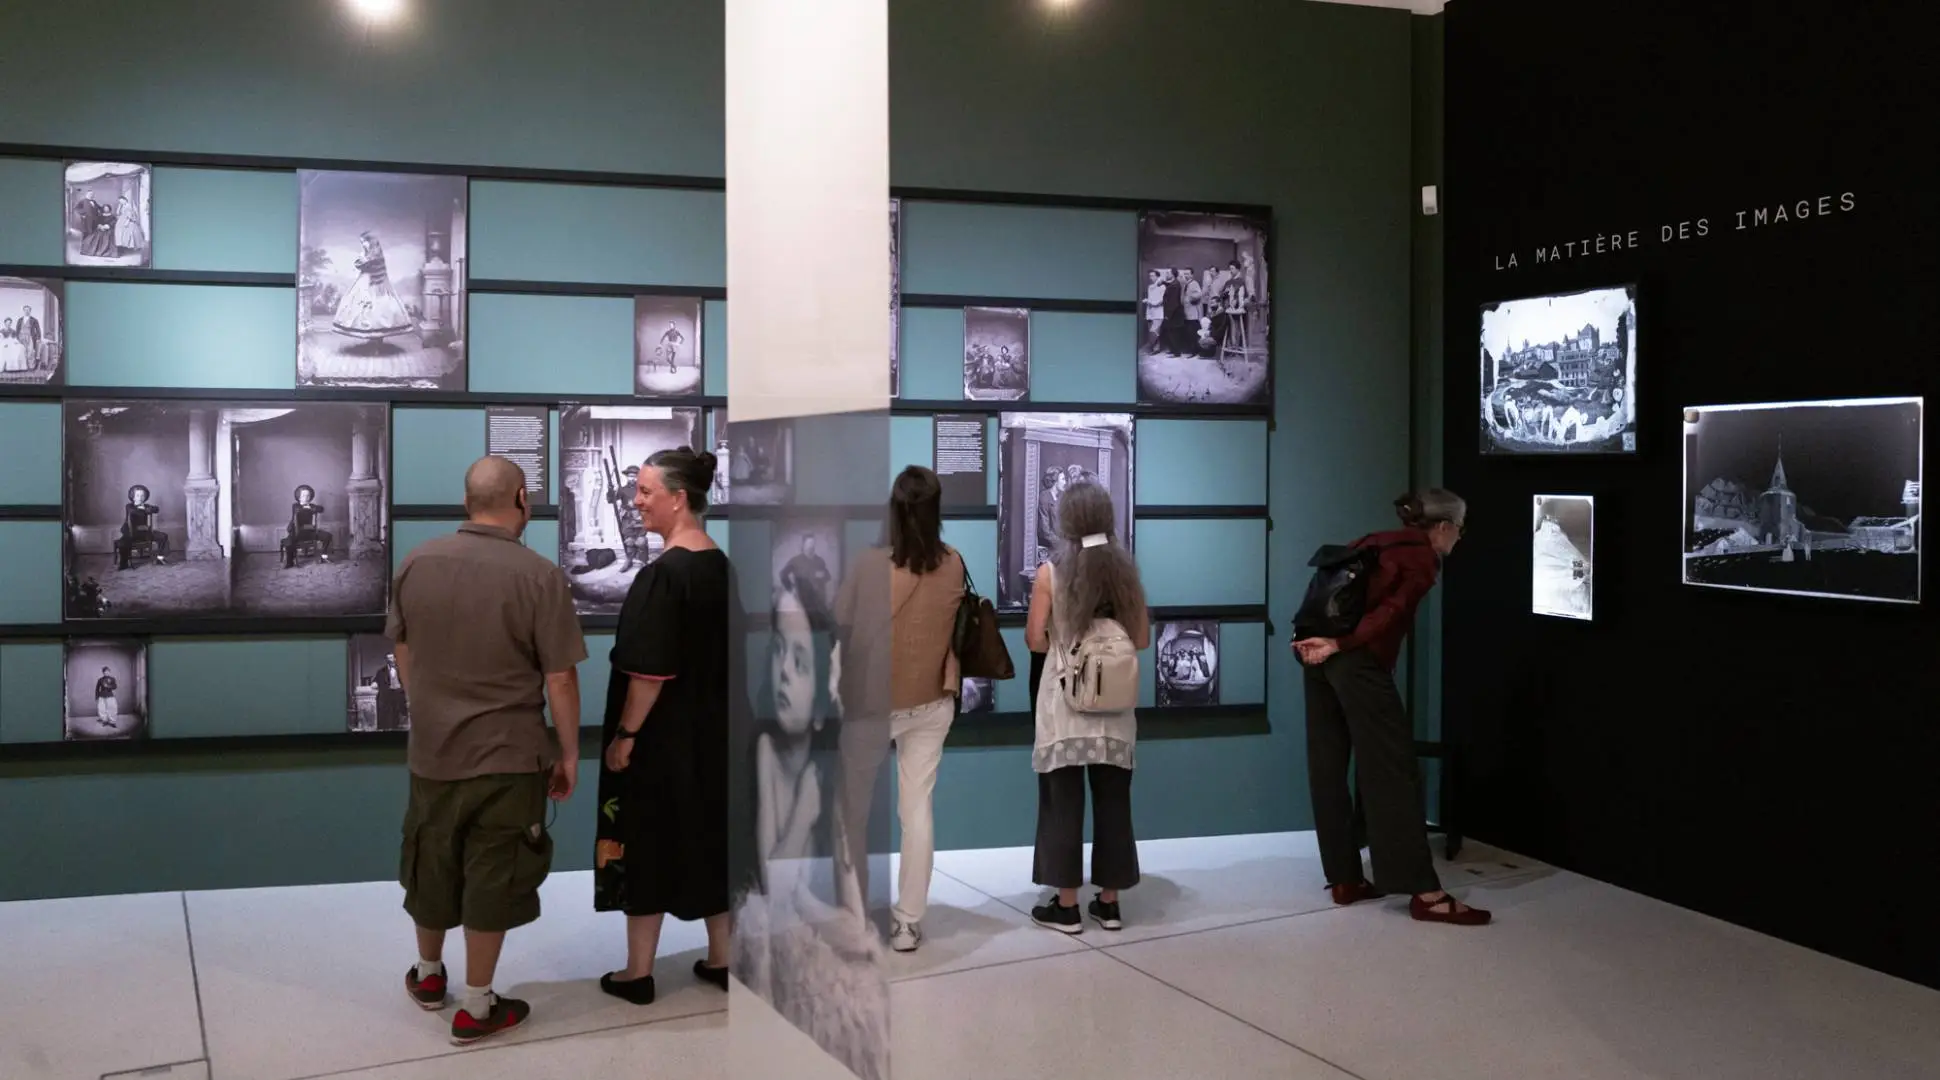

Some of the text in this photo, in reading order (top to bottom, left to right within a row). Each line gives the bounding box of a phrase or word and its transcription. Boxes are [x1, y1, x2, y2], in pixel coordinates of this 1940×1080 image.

[1495, 191, 1855, 271] LA MATIÈRE DES IMAGES
